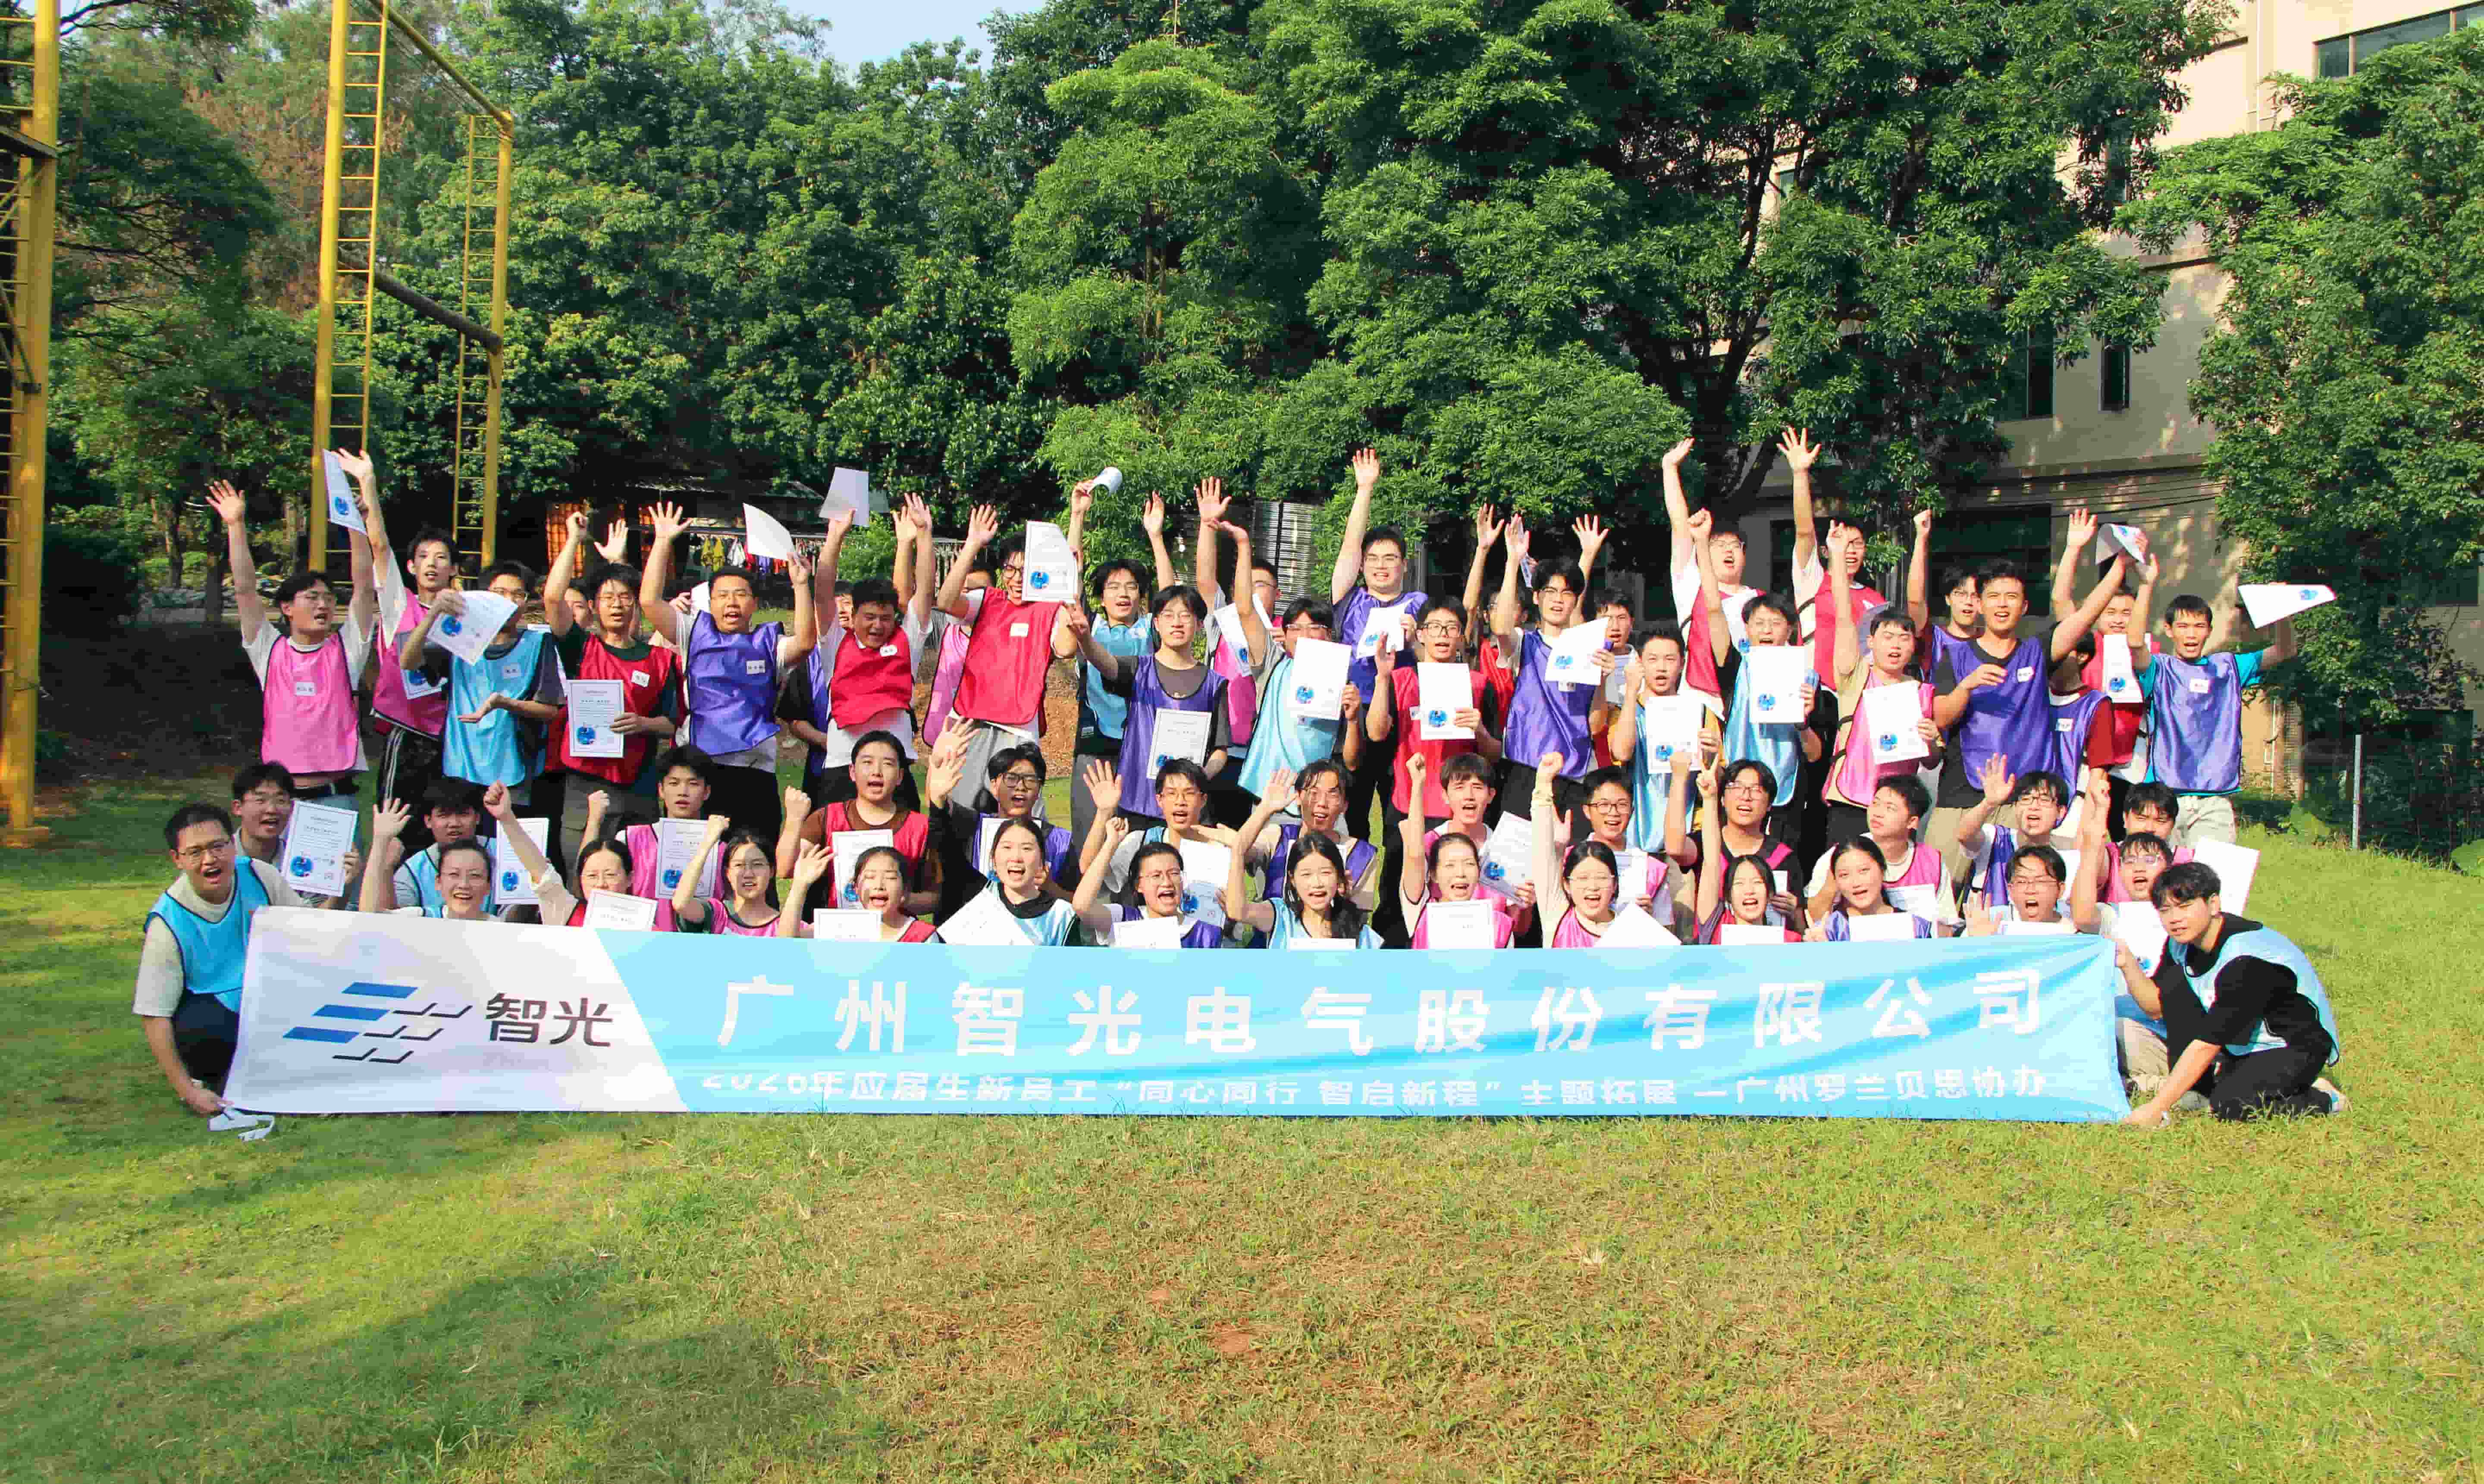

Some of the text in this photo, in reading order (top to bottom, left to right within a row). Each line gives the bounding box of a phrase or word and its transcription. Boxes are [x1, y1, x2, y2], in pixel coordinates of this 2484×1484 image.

[485, 993, 613, 1047] 智光
[717, 969, 2041, 1057] 广州智光电气股份有限公司
